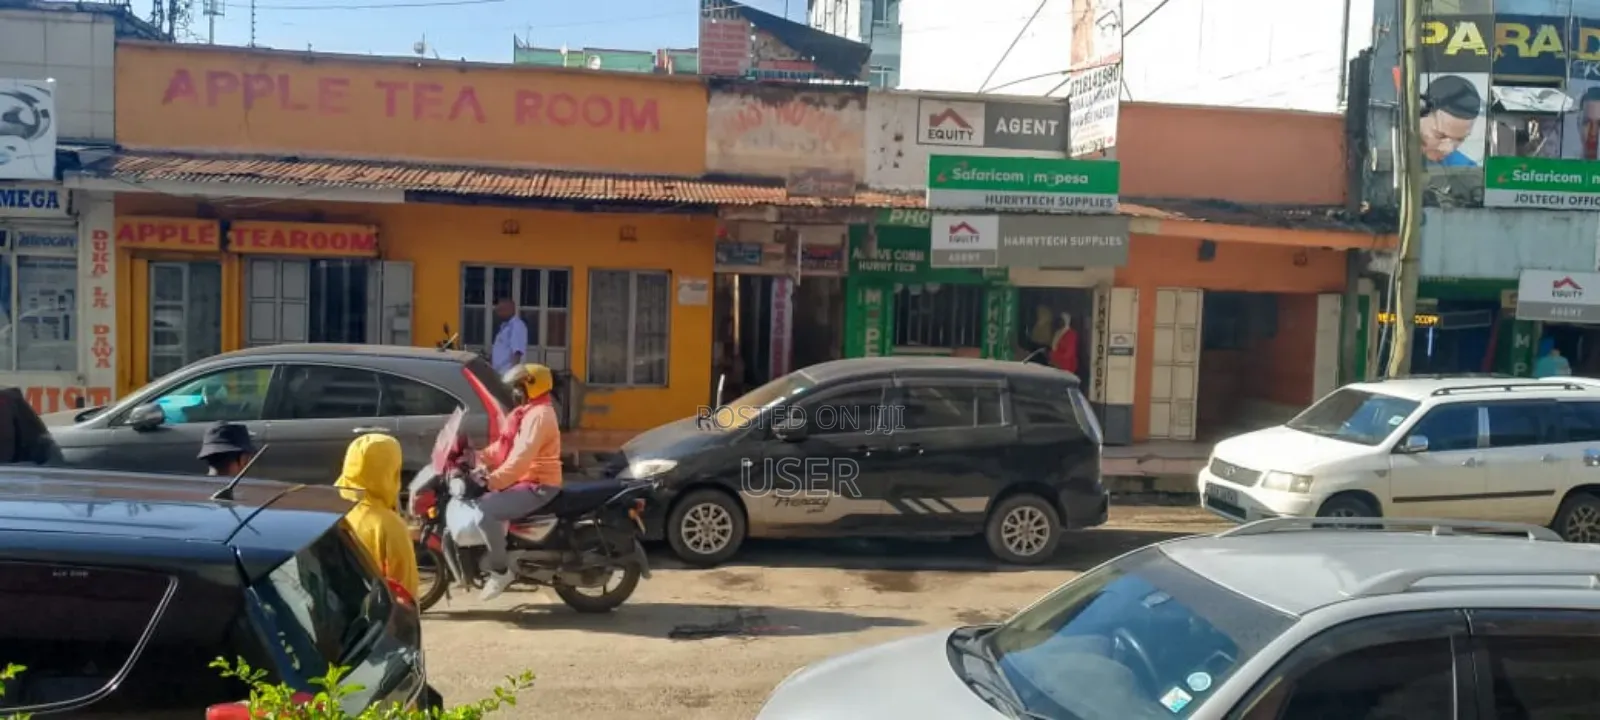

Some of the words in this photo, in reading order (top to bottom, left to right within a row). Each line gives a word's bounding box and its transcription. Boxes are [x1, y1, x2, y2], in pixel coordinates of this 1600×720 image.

[162, 68, 350, 115] APPLE
[375, 80, 486, 124] TEA
[514, 88, 661, 133] ROOM
[928, 128, 974, 141] EQUITY
[995, 117, 1058, 137] AGENT
[952, 167, 1024, 182] Safaricom
[1512, 169, 1582, 184] Safaricom
[0, 189, 60, 209] MEGA
[985, 194, 1055, 207] HURRYTECH
[1058, 197, 1113, 209] SUPPLIES
[1514, 193, 1564, 206] JOLTECH
[116, 223, 216, 245] APPLE
[229, 227, 375, 250] TEAROOM
[1070, 236, 1122, 246] SUPPLIES
